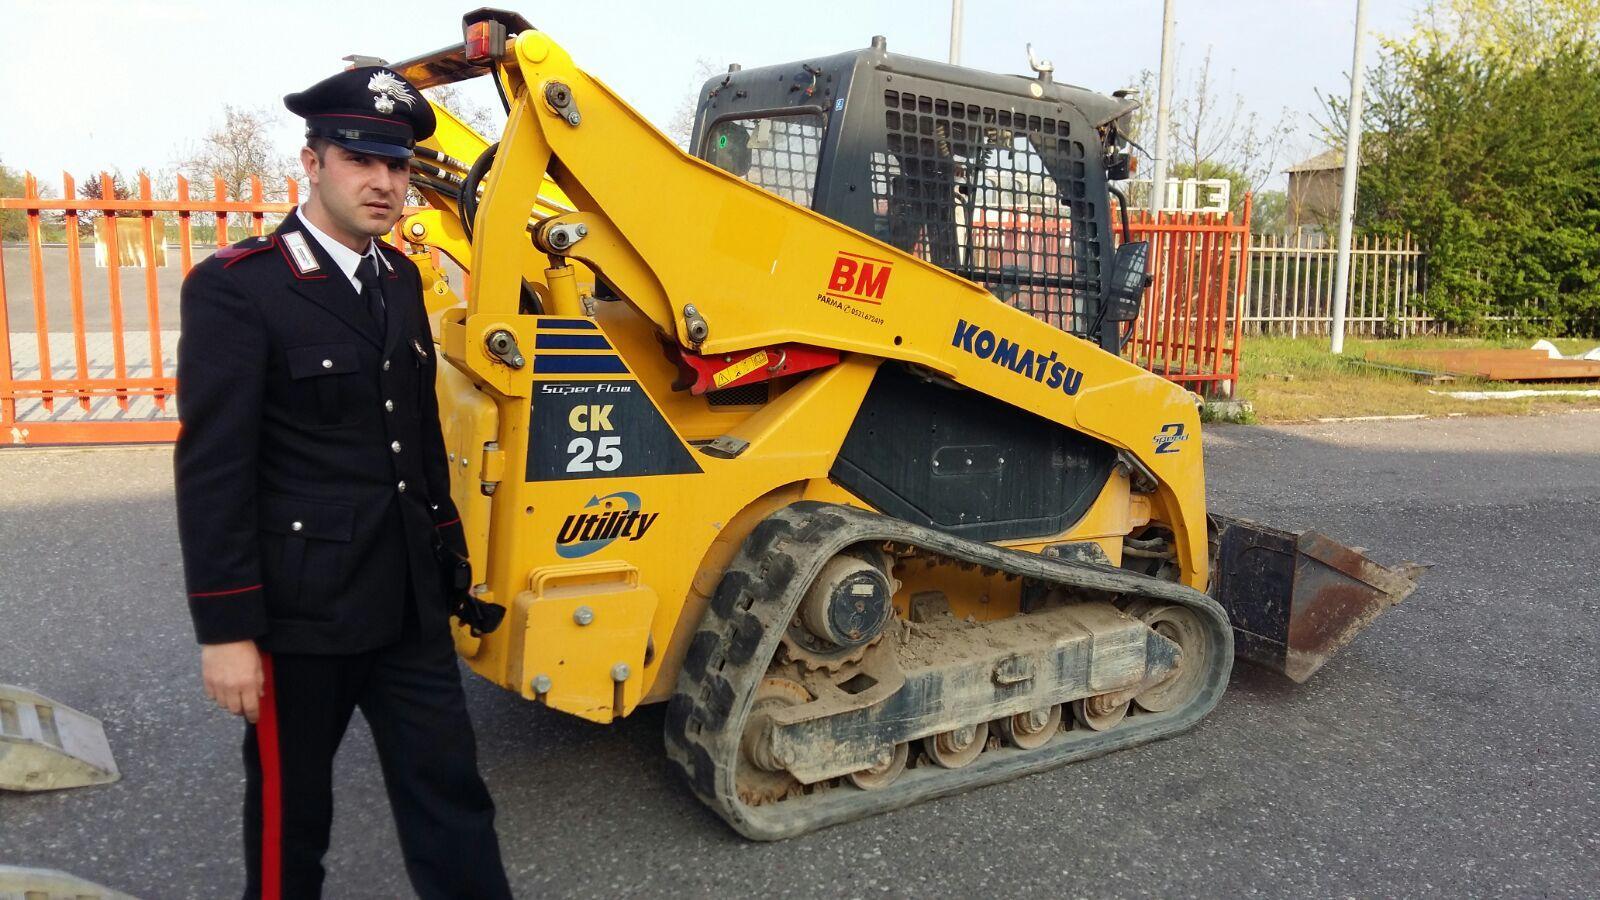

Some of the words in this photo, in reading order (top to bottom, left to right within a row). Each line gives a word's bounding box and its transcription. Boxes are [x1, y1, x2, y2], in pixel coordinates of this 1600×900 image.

[828, 257, 892, 300] BM
[817, 293, 843, 310] PARMA
[951, 318, 1083, 396] KOMATSU
[541, 383, 595, 395] Super
[597, 383, 632, 393] Flow
[568, 404, 614, 432] CK
[566, 436, 623, 473] 25
[1155, 423, 1184, 454] 2
[556, 510, 660, 544] Utility
